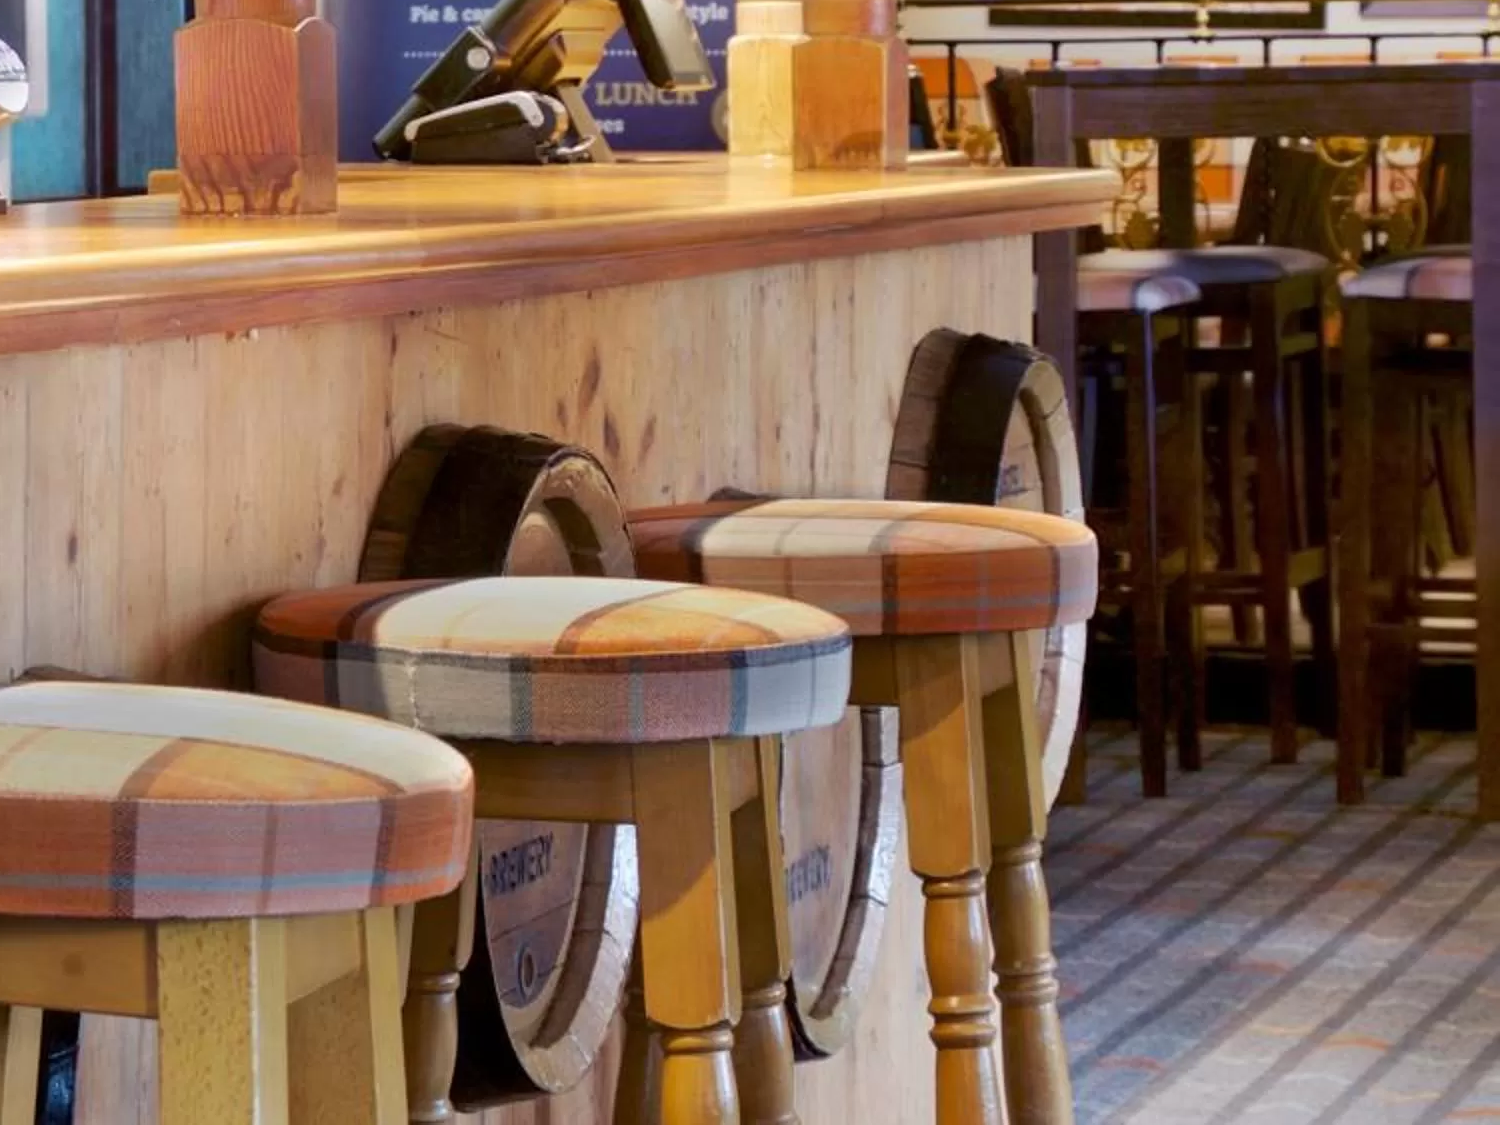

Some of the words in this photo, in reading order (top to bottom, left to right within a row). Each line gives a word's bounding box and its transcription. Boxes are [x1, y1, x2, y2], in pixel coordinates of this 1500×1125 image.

[409, 4, 440, 23] Pie
[442, 4, 459, 24] &
[489, 830, 555, 897] BREWERY
